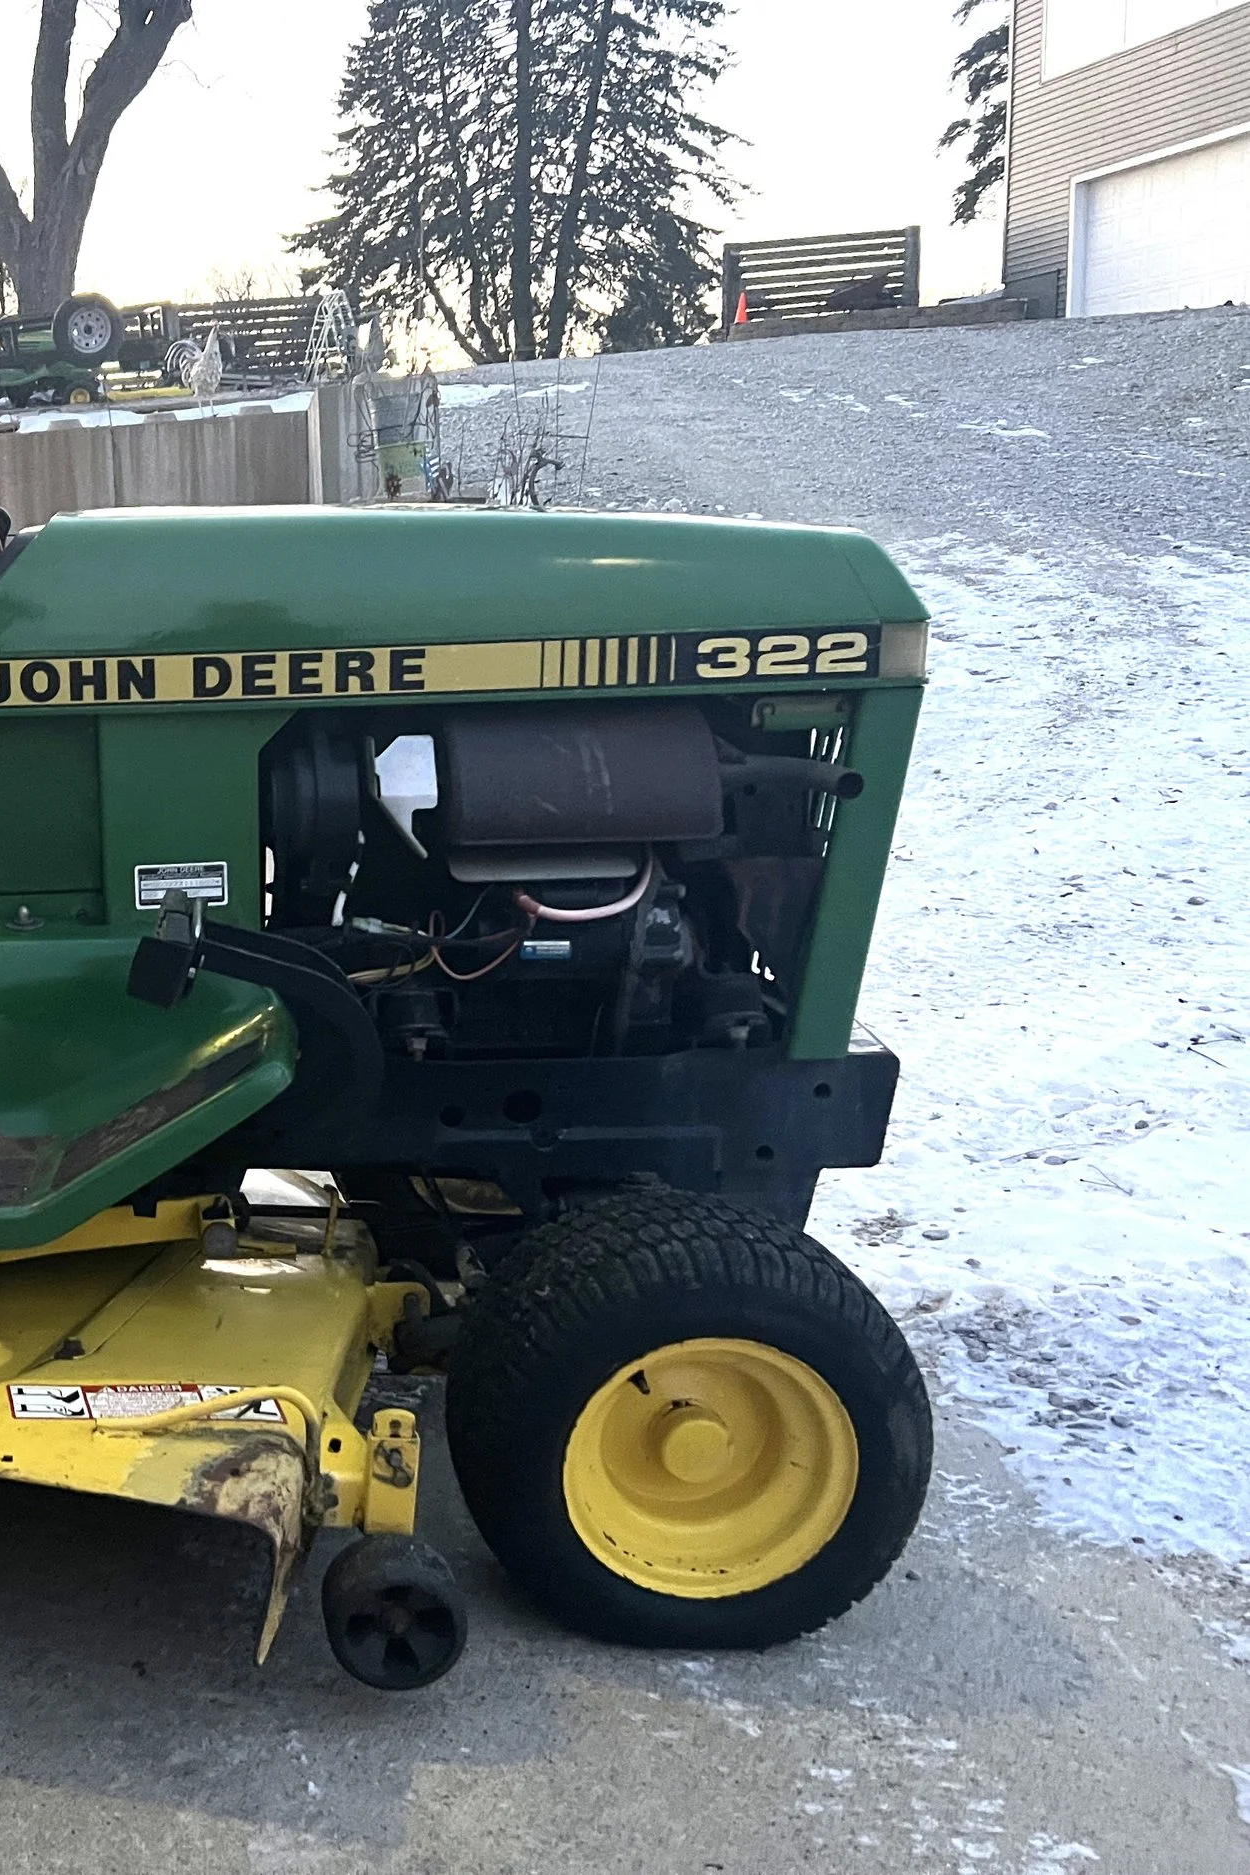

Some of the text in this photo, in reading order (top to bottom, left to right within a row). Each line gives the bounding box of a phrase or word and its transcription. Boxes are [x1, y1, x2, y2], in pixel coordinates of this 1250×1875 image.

[192, 648, 426, 698] DEERE
[695, 632, 868, 678] 322
[116, 1384, 182, 1393] DANGER
